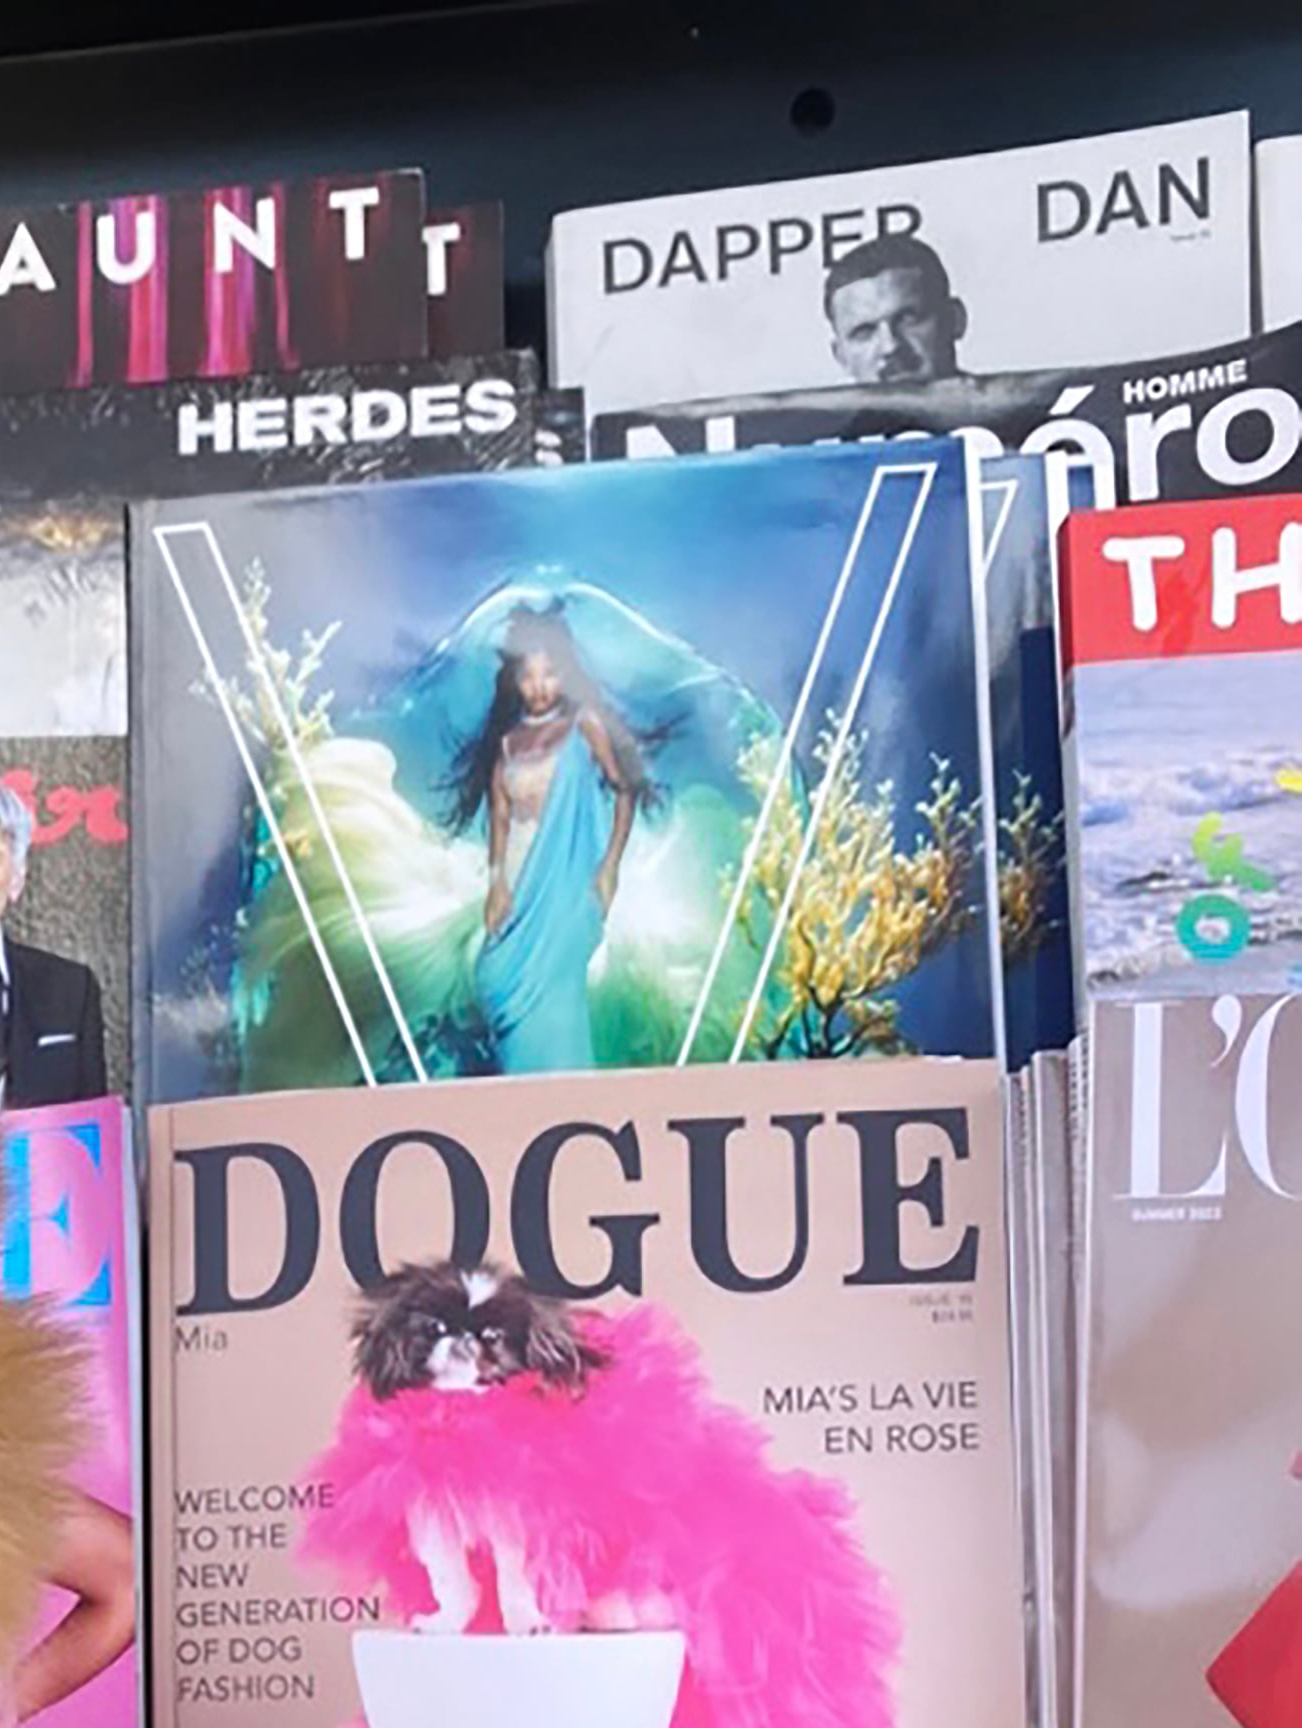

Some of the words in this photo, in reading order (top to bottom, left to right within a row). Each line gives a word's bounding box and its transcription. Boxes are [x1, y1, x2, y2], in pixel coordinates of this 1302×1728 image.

[1036, 156, 1211, 243] DAN
[1123, 358, 1248, 405] HOMME
[178, 379, 517, 456] HERDES
[174, 1106, 980, 1318] DOGUE
[176, 1323, 228, 1353] Mia
[763, 1384, 858, 1413] MIA'S
[870, 1382, 915, 1411] LA
[921, 1379, 979, 1409] VIE
[824, 1425, 874, 1453] EN
[886, 1422, 980, 1452] ROSE
[174, 1483, 336, 1514] WELCOME
[176, 1526, 218, 1551] TO
[226, 1523, 288, 1549] THE
[175, 1563, 249, 1589] NEW
[175, 1596, 381, 1628] GENERATION
[175, 1639, 220, 1665] OF
[228, 1635, 303, 1663] DOG
[176, 1674, 316, 1702] FASHION
